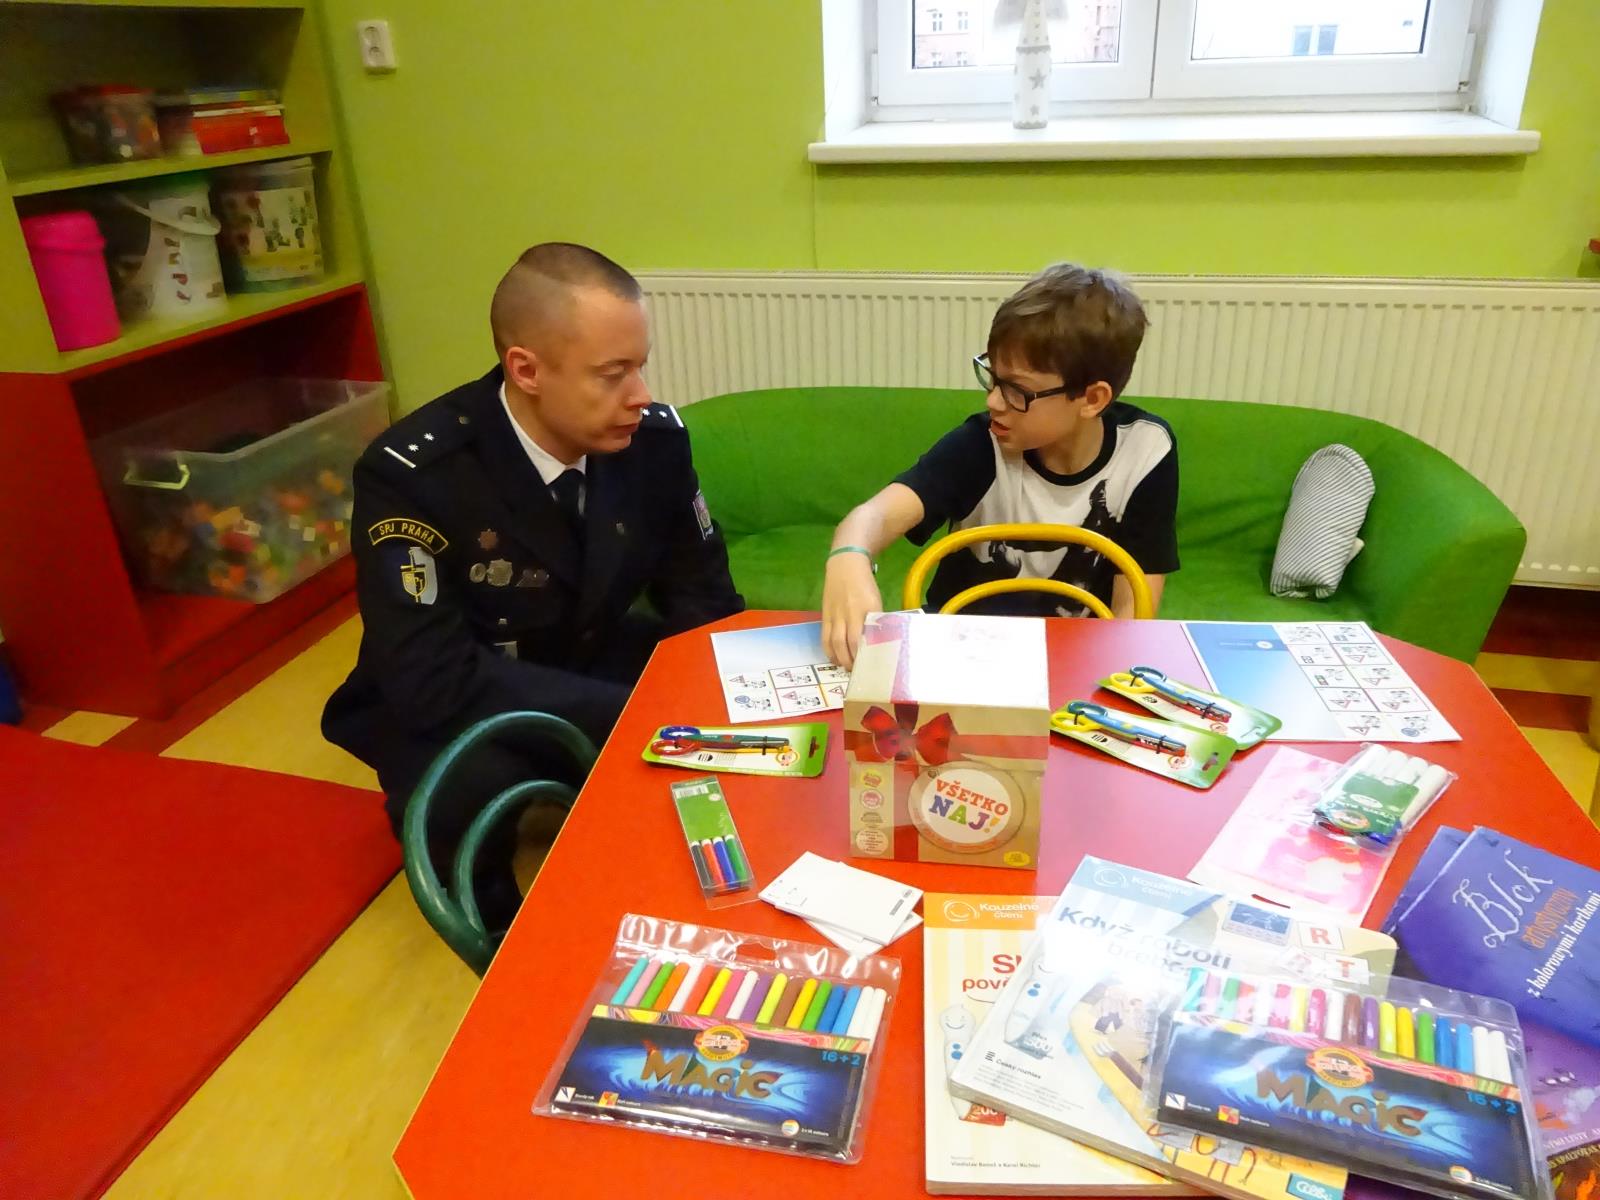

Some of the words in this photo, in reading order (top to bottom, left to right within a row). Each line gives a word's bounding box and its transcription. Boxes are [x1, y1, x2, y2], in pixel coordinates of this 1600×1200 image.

[401, 522, 435, 544] PRAHA
[928, 795, 1001, 834] NAJ!
[936, 778, 1009, 816] VŠETKO
[1058, 906, 1134, 939] Když
[1309, 927, 1332, 945] R
[1526, 931, 1577, 990] kolorowymi
